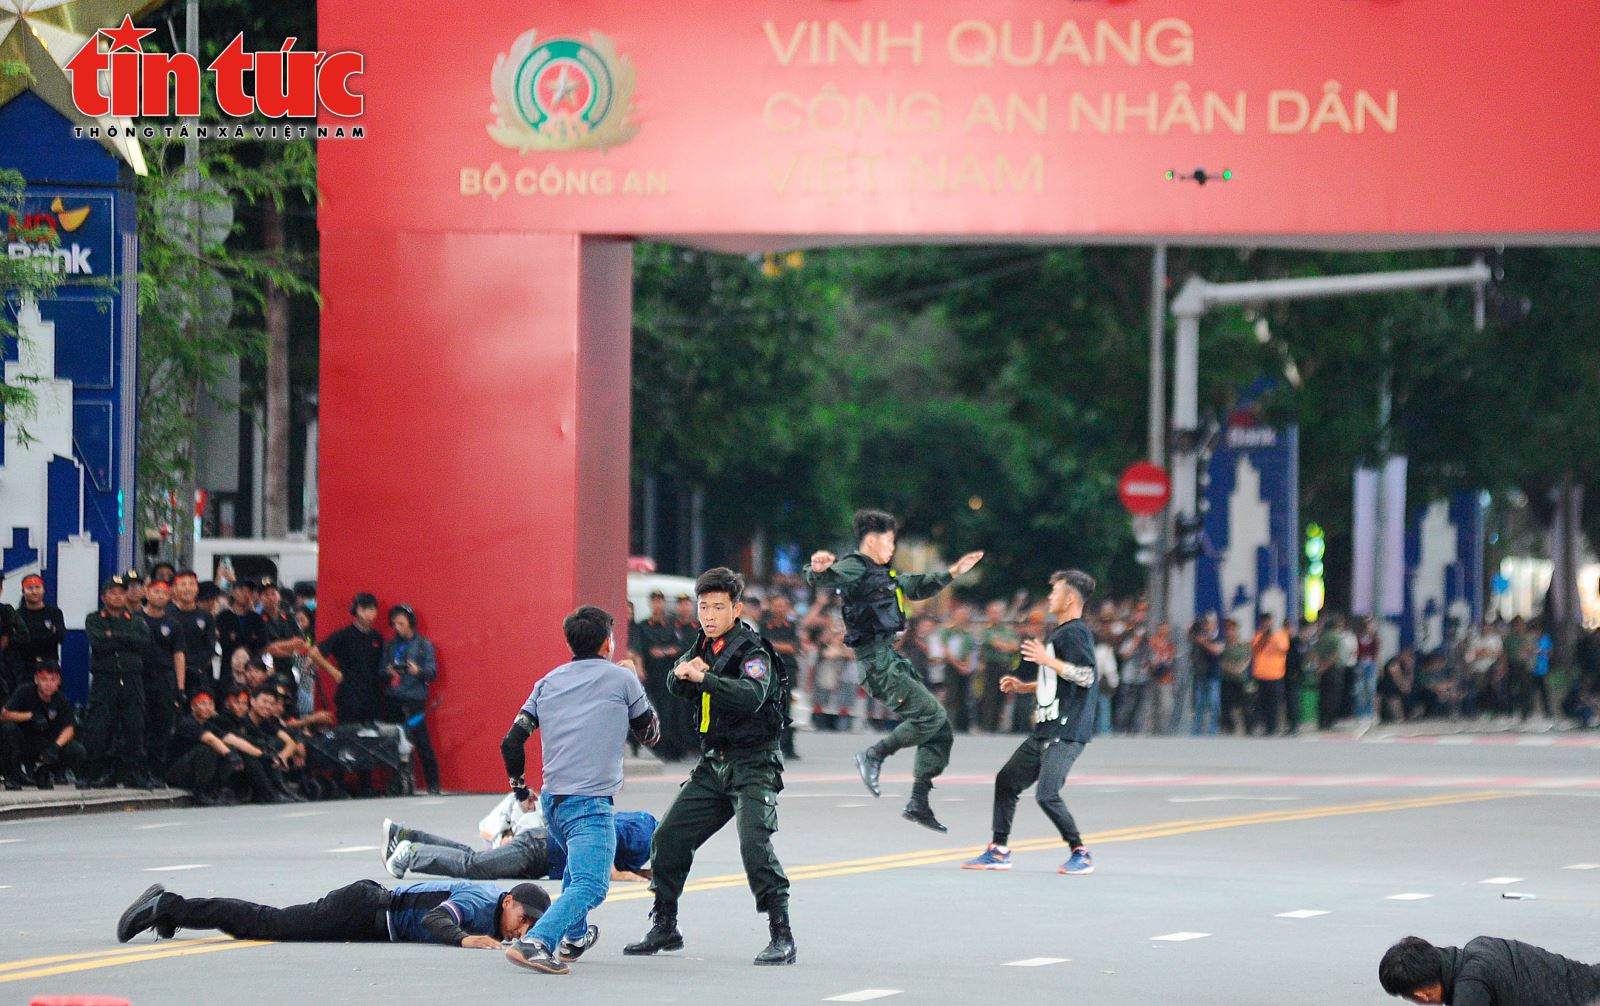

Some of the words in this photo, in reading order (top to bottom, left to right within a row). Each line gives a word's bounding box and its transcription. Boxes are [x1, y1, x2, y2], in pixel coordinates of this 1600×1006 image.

[763, 20, 924, 67] VINH
[947, 18, 1195, 68] QUANG
[762, 82, 943, 135] CÔNG
[963, 92, 1048, 134] AN
[1068, 81, 1248, 134] NHÂN
[1268, 80, 1399, 134] DÂN
[459, 162, 508, 200] BỘ
[514, 163, 615, 196] CÔNG
[622, 168, 671, 196] AN
[906, 153, 1046, 194] NAM
